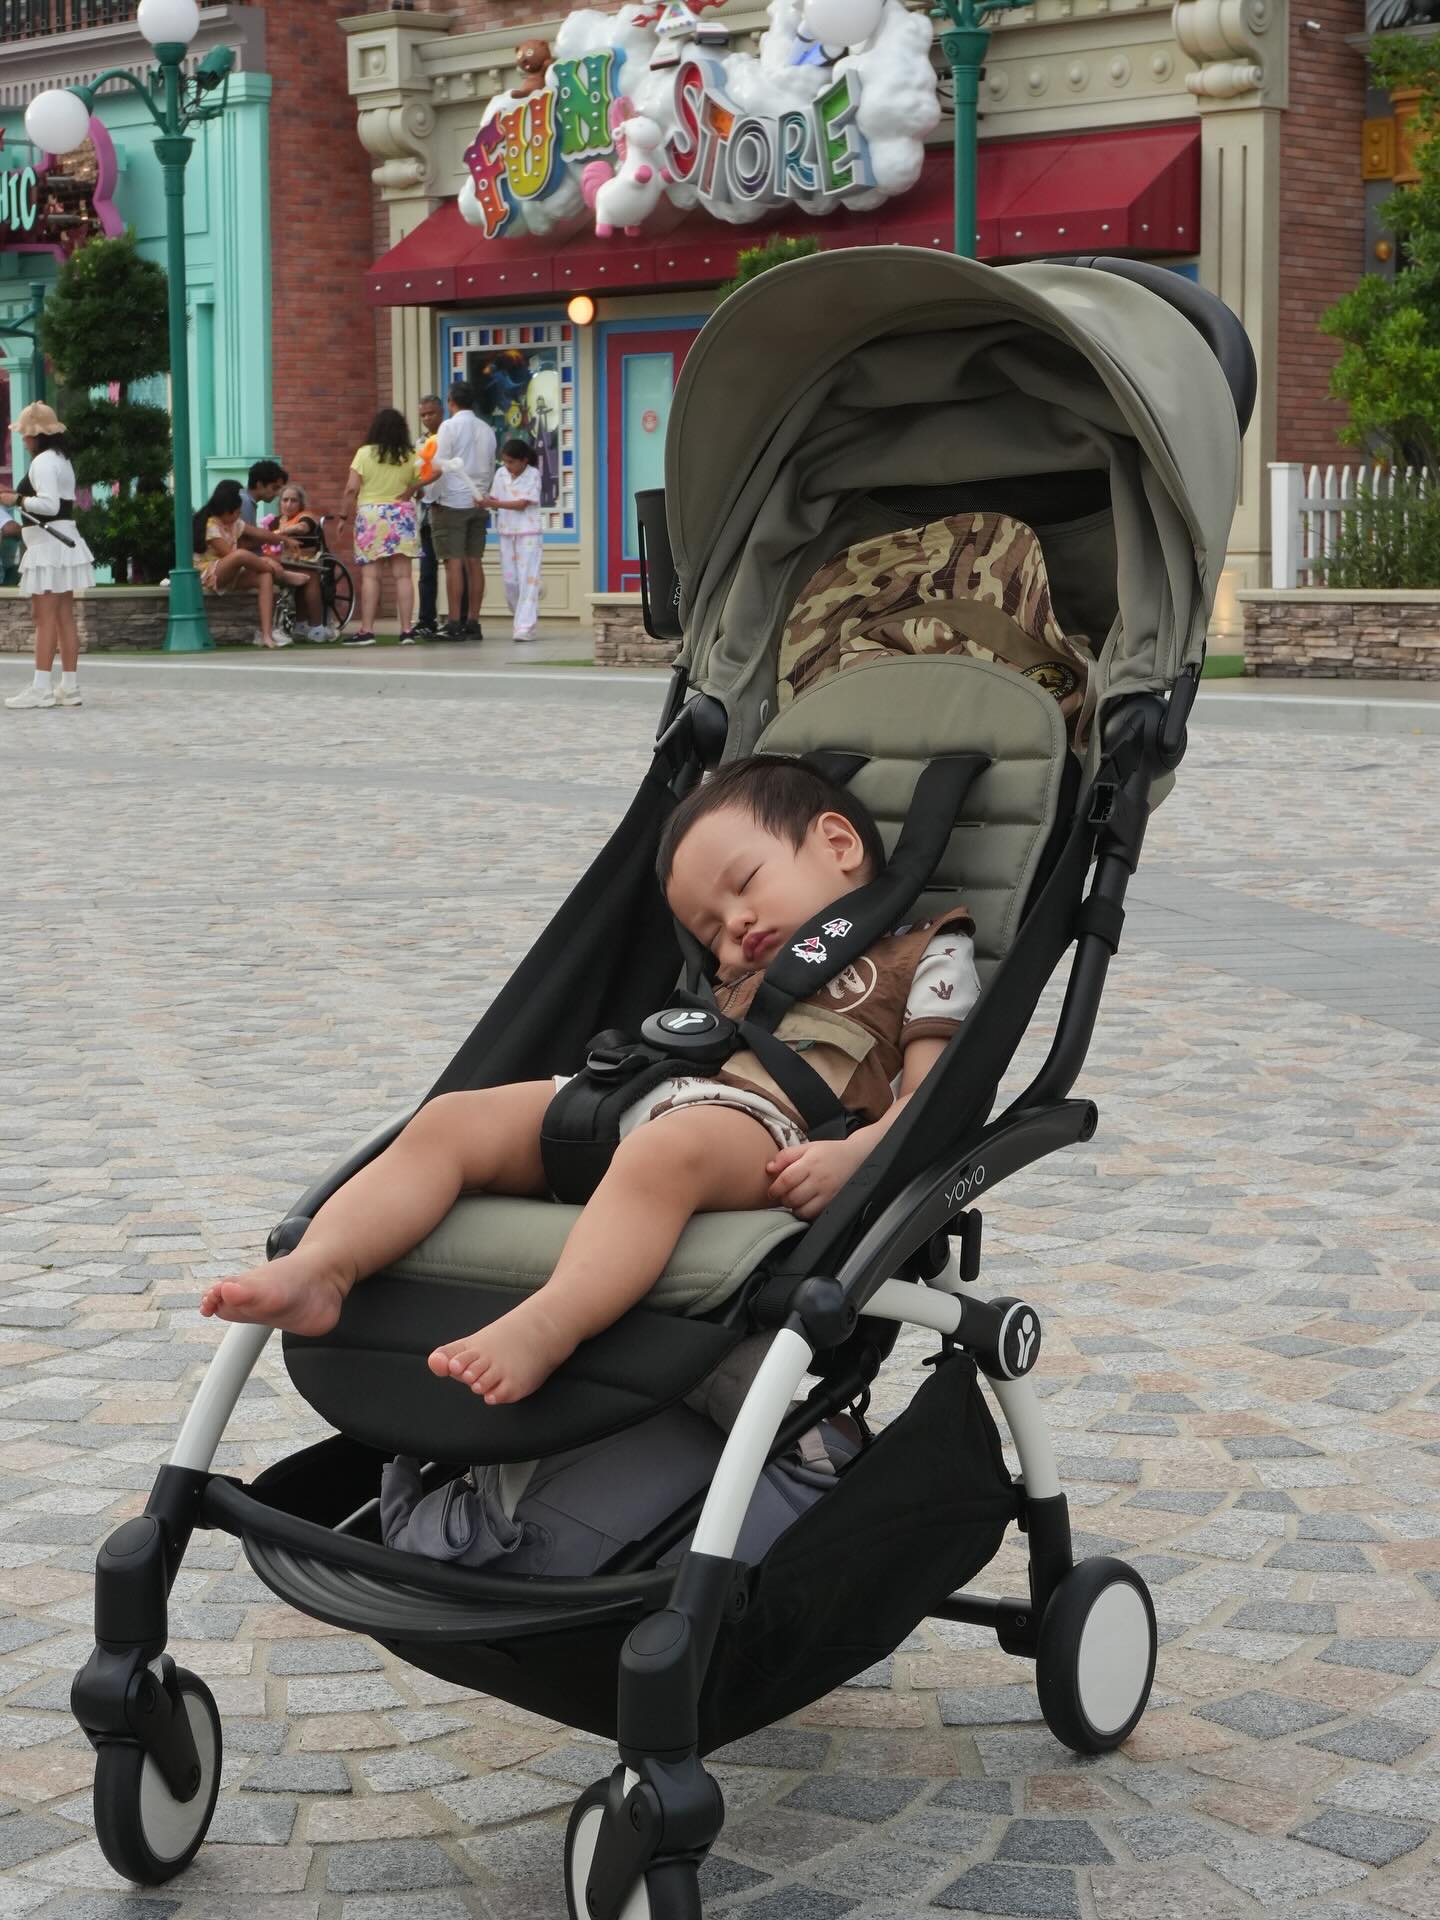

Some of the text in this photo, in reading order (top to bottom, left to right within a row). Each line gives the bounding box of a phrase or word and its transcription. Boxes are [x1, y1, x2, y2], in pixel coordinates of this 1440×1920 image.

[463, 47, 864, 239] FUN STORE
[944, 1165, 985, 1208] YOYO
